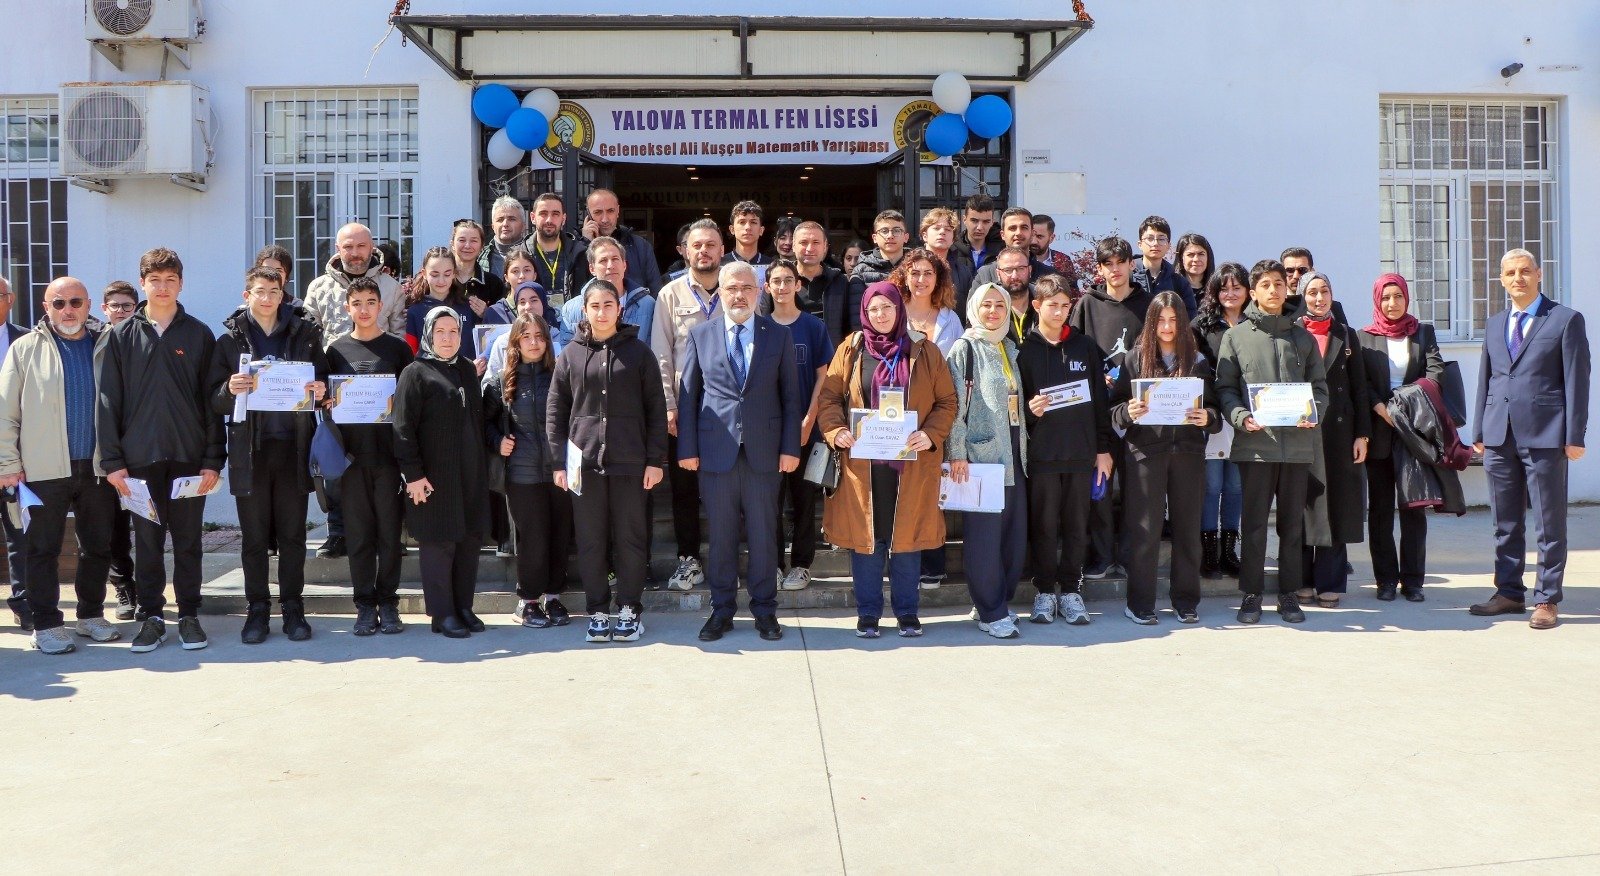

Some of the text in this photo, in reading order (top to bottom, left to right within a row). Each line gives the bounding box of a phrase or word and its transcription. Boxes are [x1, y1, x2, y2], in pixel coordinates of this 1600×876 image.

[611, 104, 878, 131] YALOVA TERMAL FEN LİSESİ
[904, 104, 933, 116] TERMAL
[599, 139, 890, 157] Geleneksel Ali Kuşçu Matematik Yarışması
